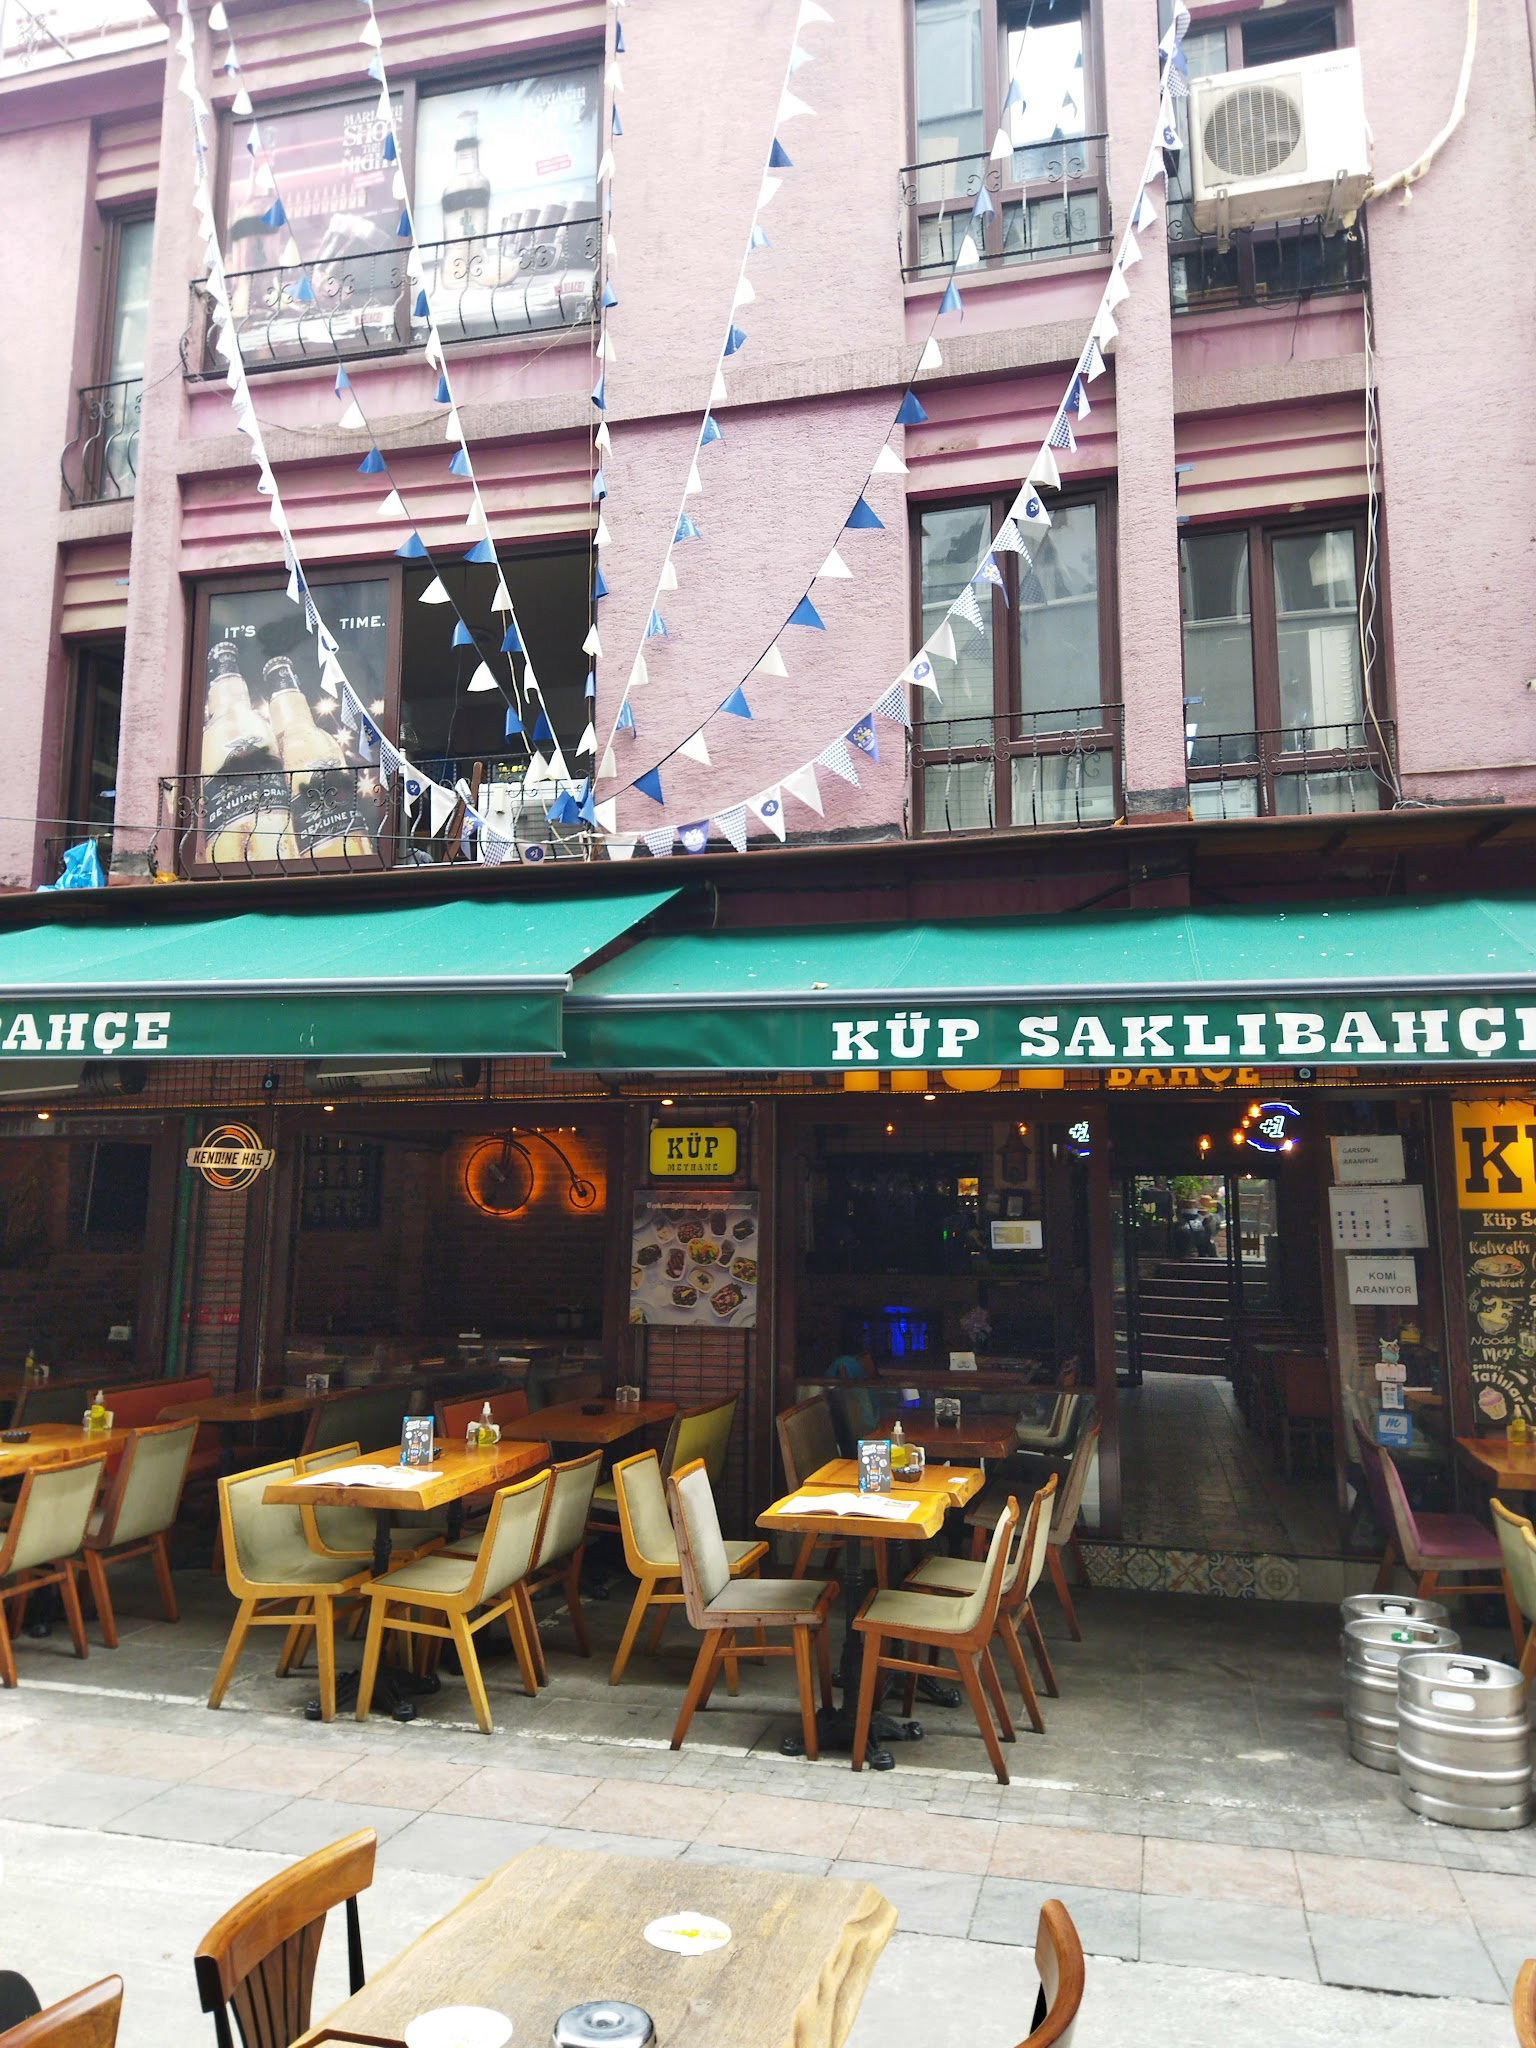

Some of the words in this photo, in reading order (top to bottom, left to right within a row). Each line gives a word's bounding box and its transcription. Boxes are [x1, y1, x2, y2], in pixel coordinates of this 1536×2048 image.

[340, 152, 398, 176] NIGH
[224, 625, 256, 639] IT'S
[339, 615, 386, 630] TIME.
[0, 1012, 171, 1055] AHÇE
[832, 1011, 980, 1060] KÜP
[667, 1132, 719, 1159] KÜP
[241, 1152, 264, 1166] HAS
[667, 1163, 719, 1172] MEYHANE
[1462, 1122, 1536, 1194] K
[1482, 1213, 1517, 1230] Küp
[1521, 1211, 1536, 1227] S
[1368, 1270, 1397, 1280] KOMİ
[1355, 1286, 1412, 1294] ARANIYOR
